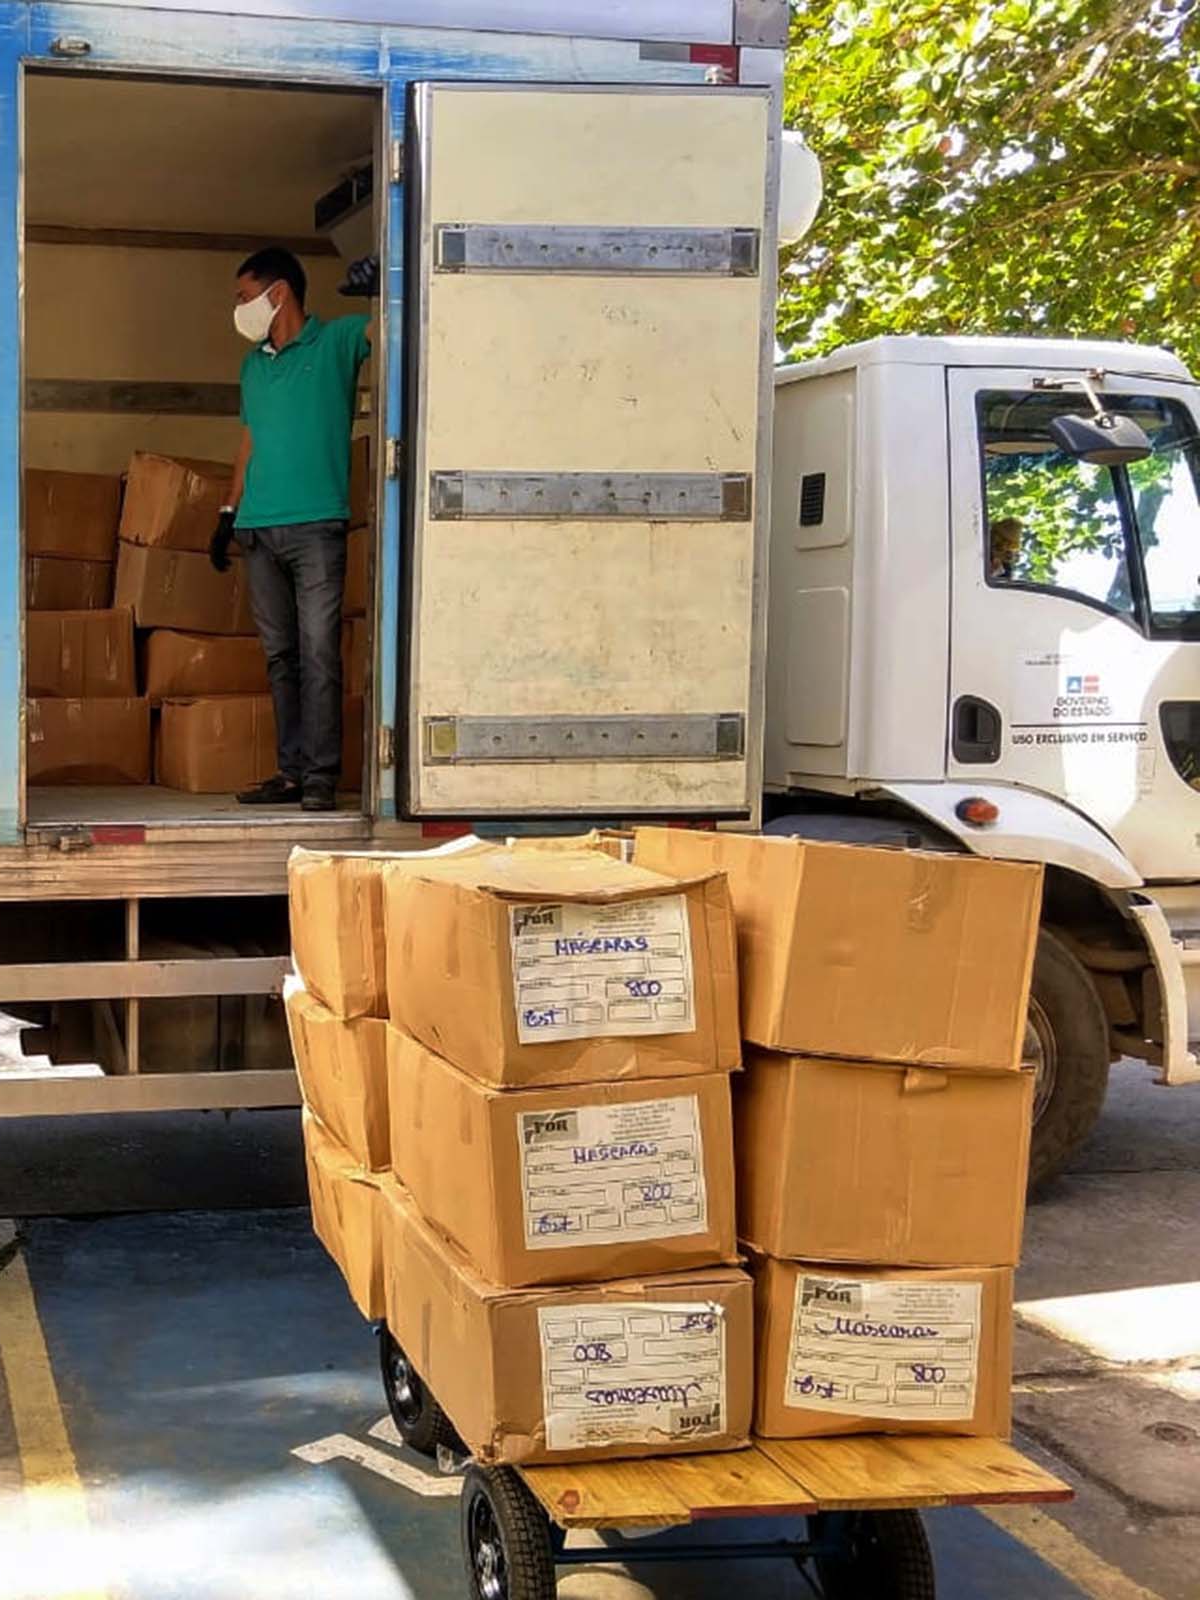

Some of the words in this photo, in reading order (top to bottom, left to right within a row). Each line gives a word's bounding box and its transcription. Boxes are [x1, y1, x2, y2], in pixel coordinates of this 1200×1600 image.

[1012, 733, 1034, 745] USO
[1036, 733, 1088, 744] EXCLUSIVO
[624, 979, 663, 997] 800
[640, 1183, 673, 1201] 800
[574, 1343, 612, 1362] 800
[911, 1363, 946, 1383] 800
